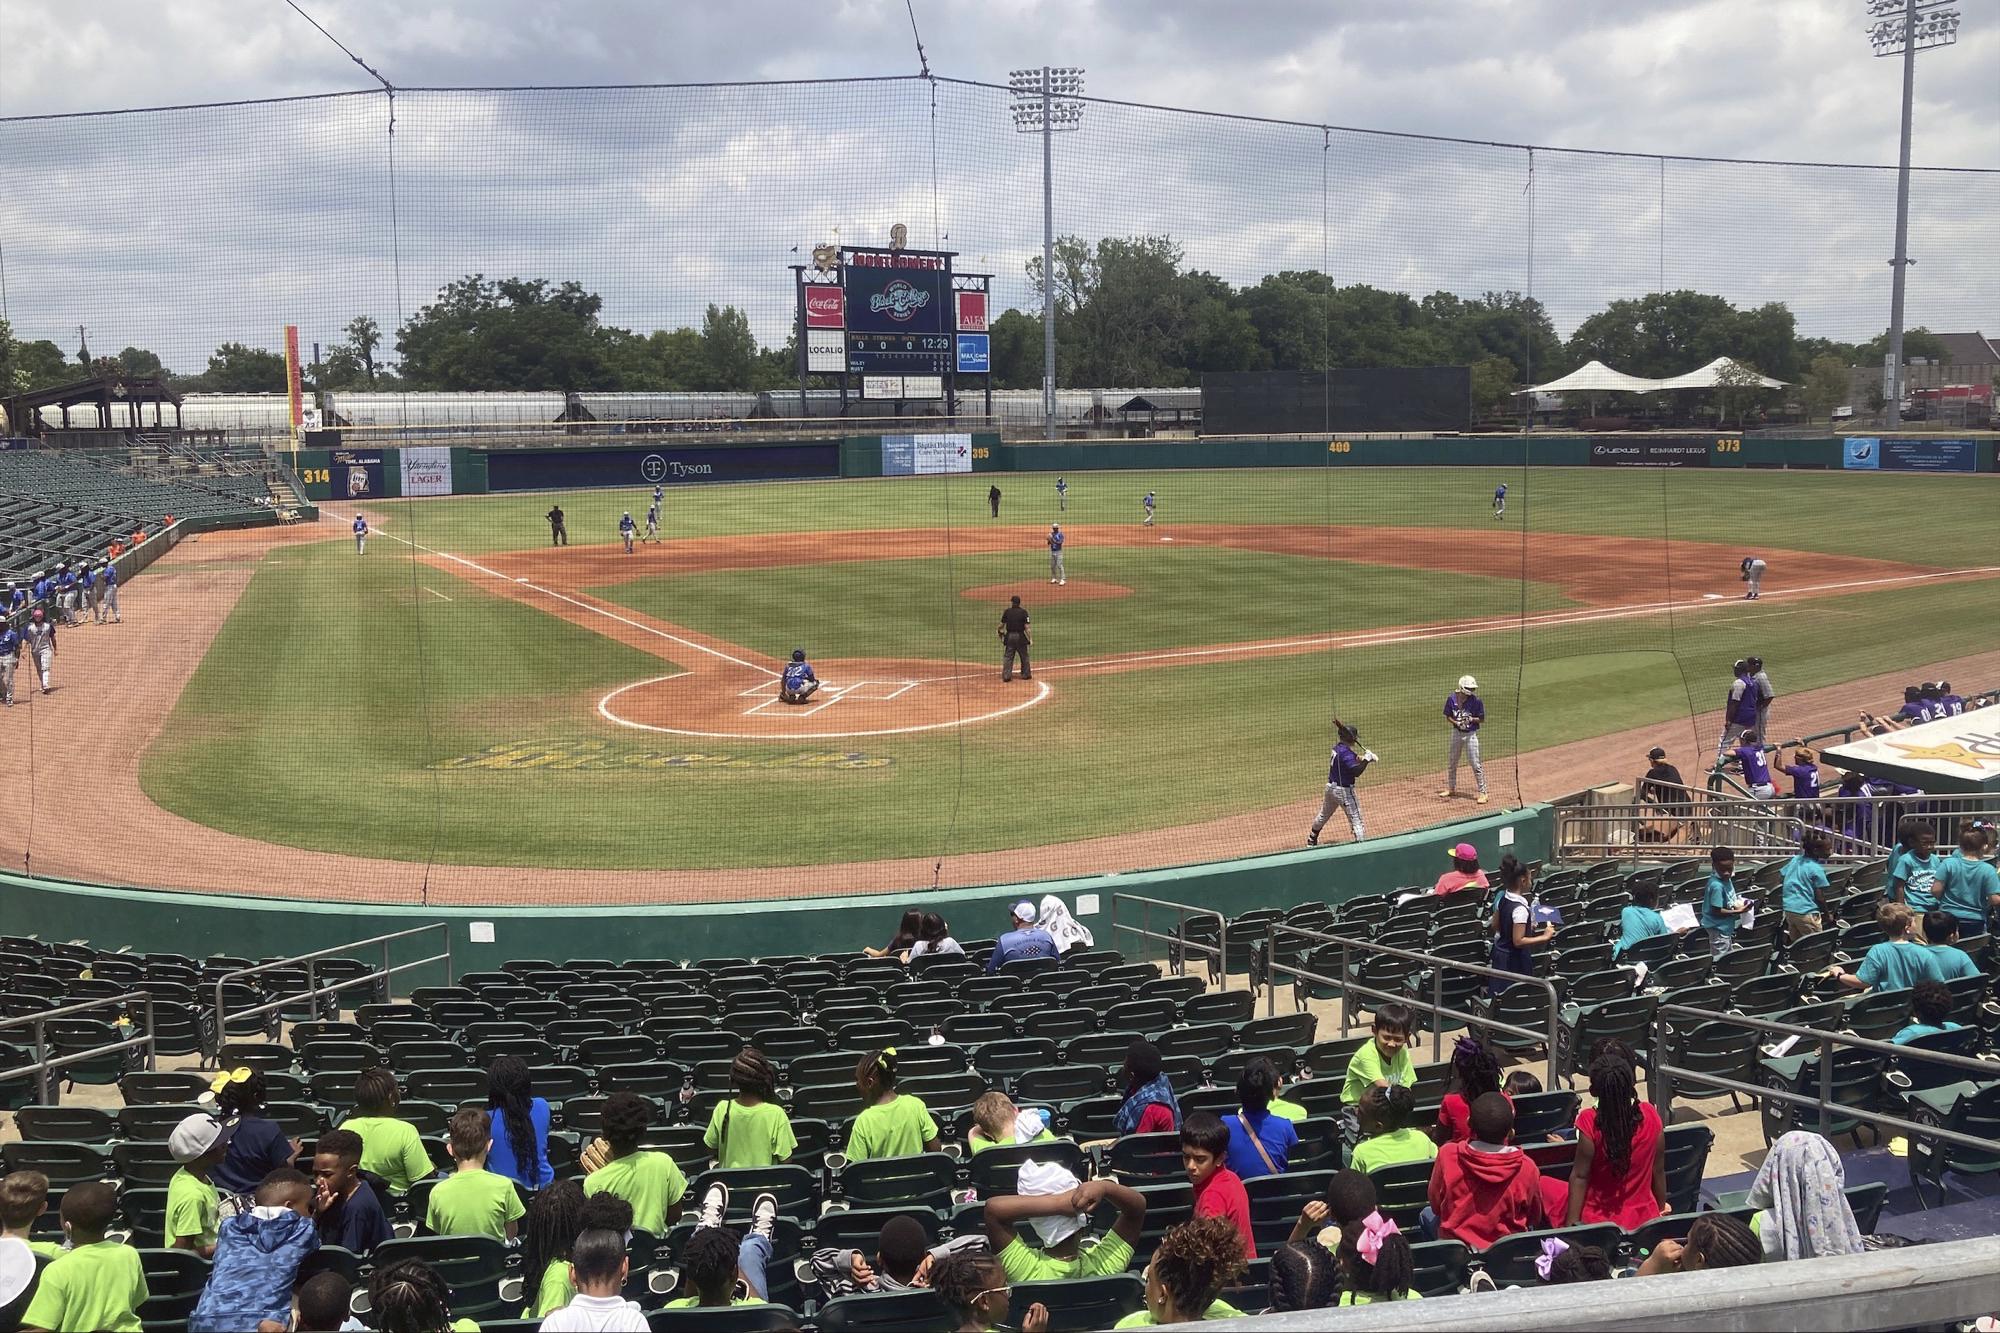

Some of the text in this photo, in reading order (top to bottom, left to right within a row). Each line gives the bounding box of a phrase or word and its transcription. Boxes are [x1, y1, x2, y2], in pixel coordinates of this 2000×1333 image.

[858, 338, 949, 350] 0 0 0 12:29
[1329, 441, 1351, 453] 400
[1717, 439, 1741, 452] 373
[973, 448, 989, 459] 395
[670, 461, 713, 477] Tyson
[303, 469, 329, 483] 314
[411, 475, 442, 484] LAGER
